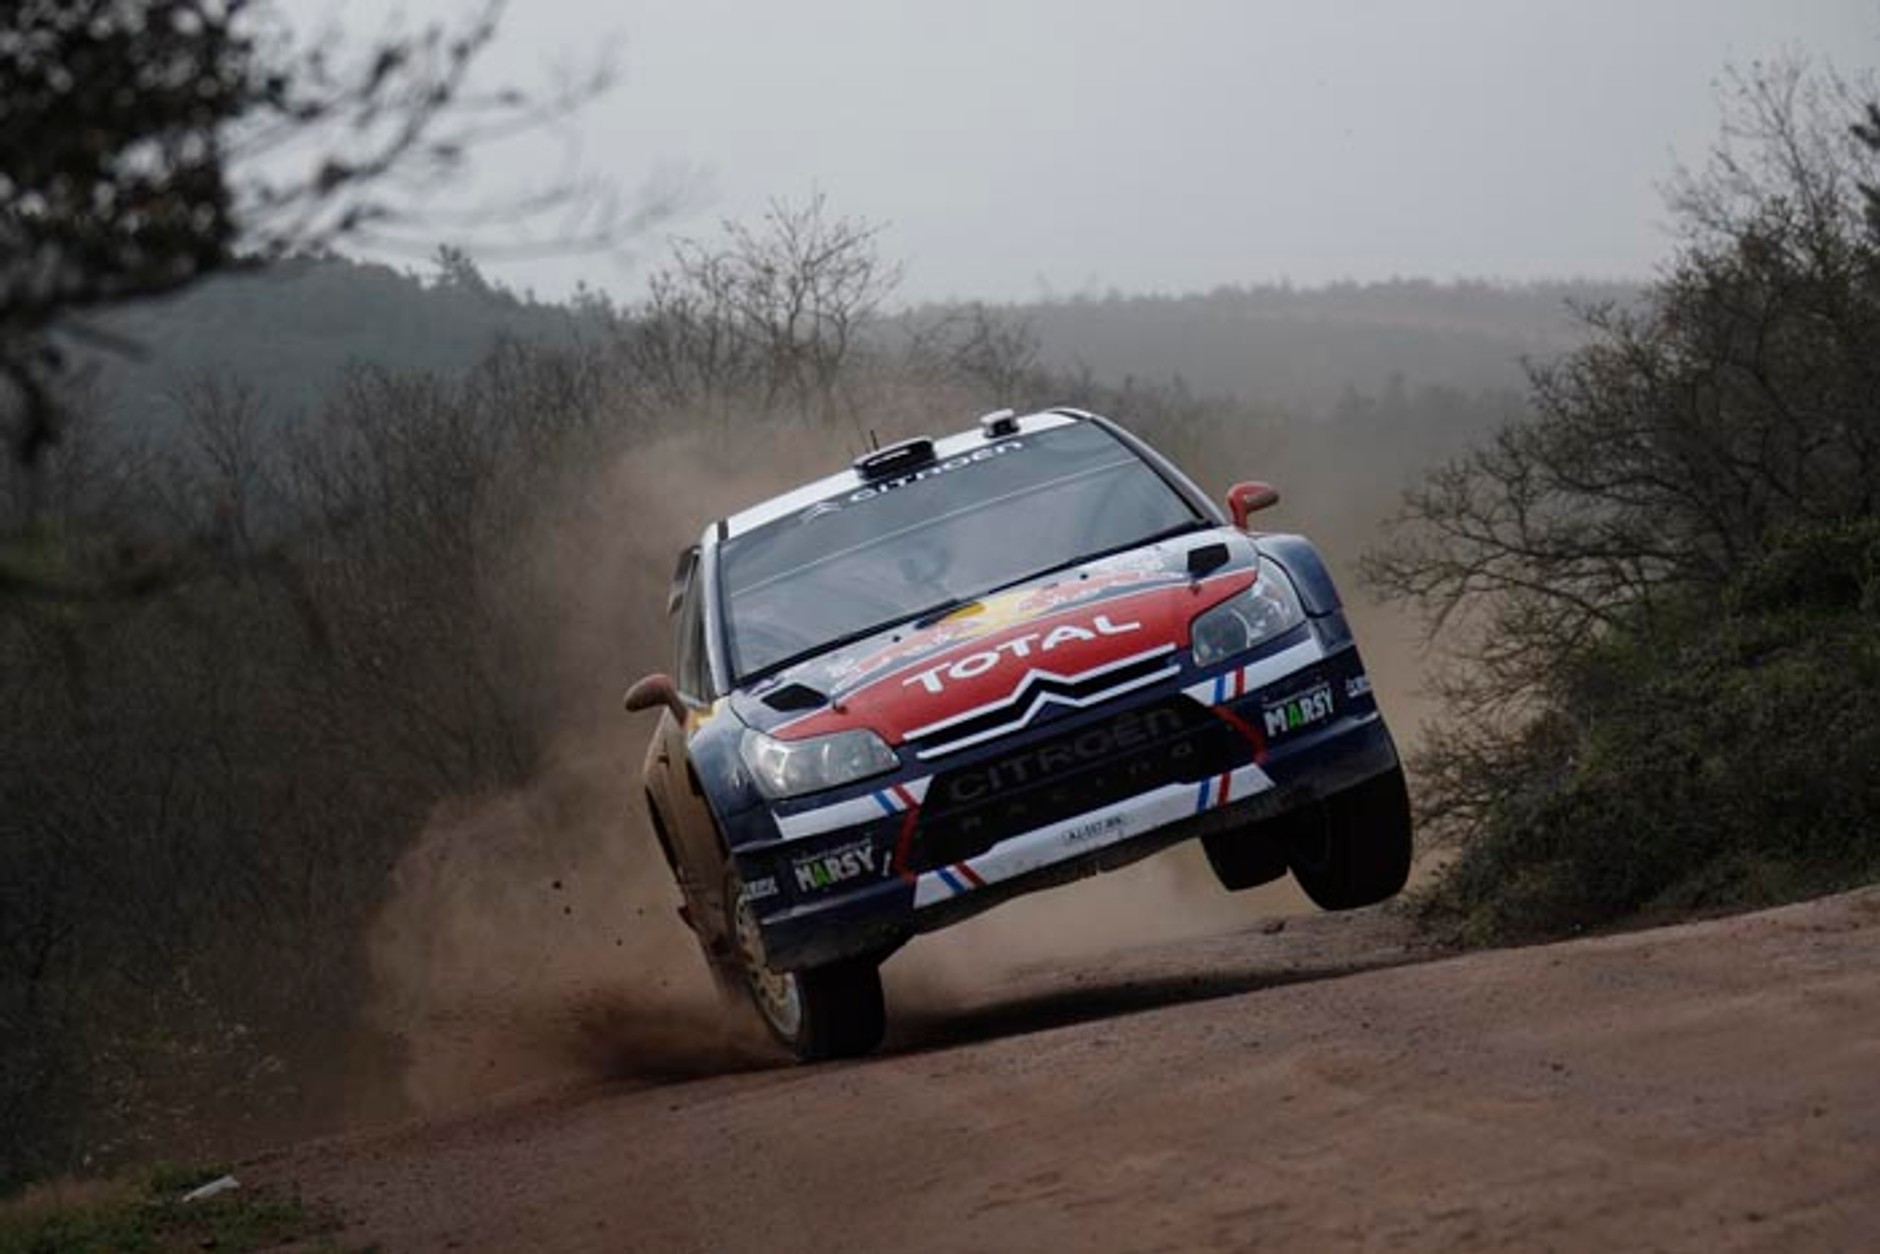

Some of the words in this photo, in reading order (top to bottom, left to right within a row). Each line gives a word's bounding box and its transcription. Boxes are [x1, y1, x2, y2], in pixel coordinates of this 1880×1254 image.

[902, 614, 1141, 693] TOTAL
[1264, 687, 1334, 738] MARSY
[794, 845, 876, 893] MARSY
